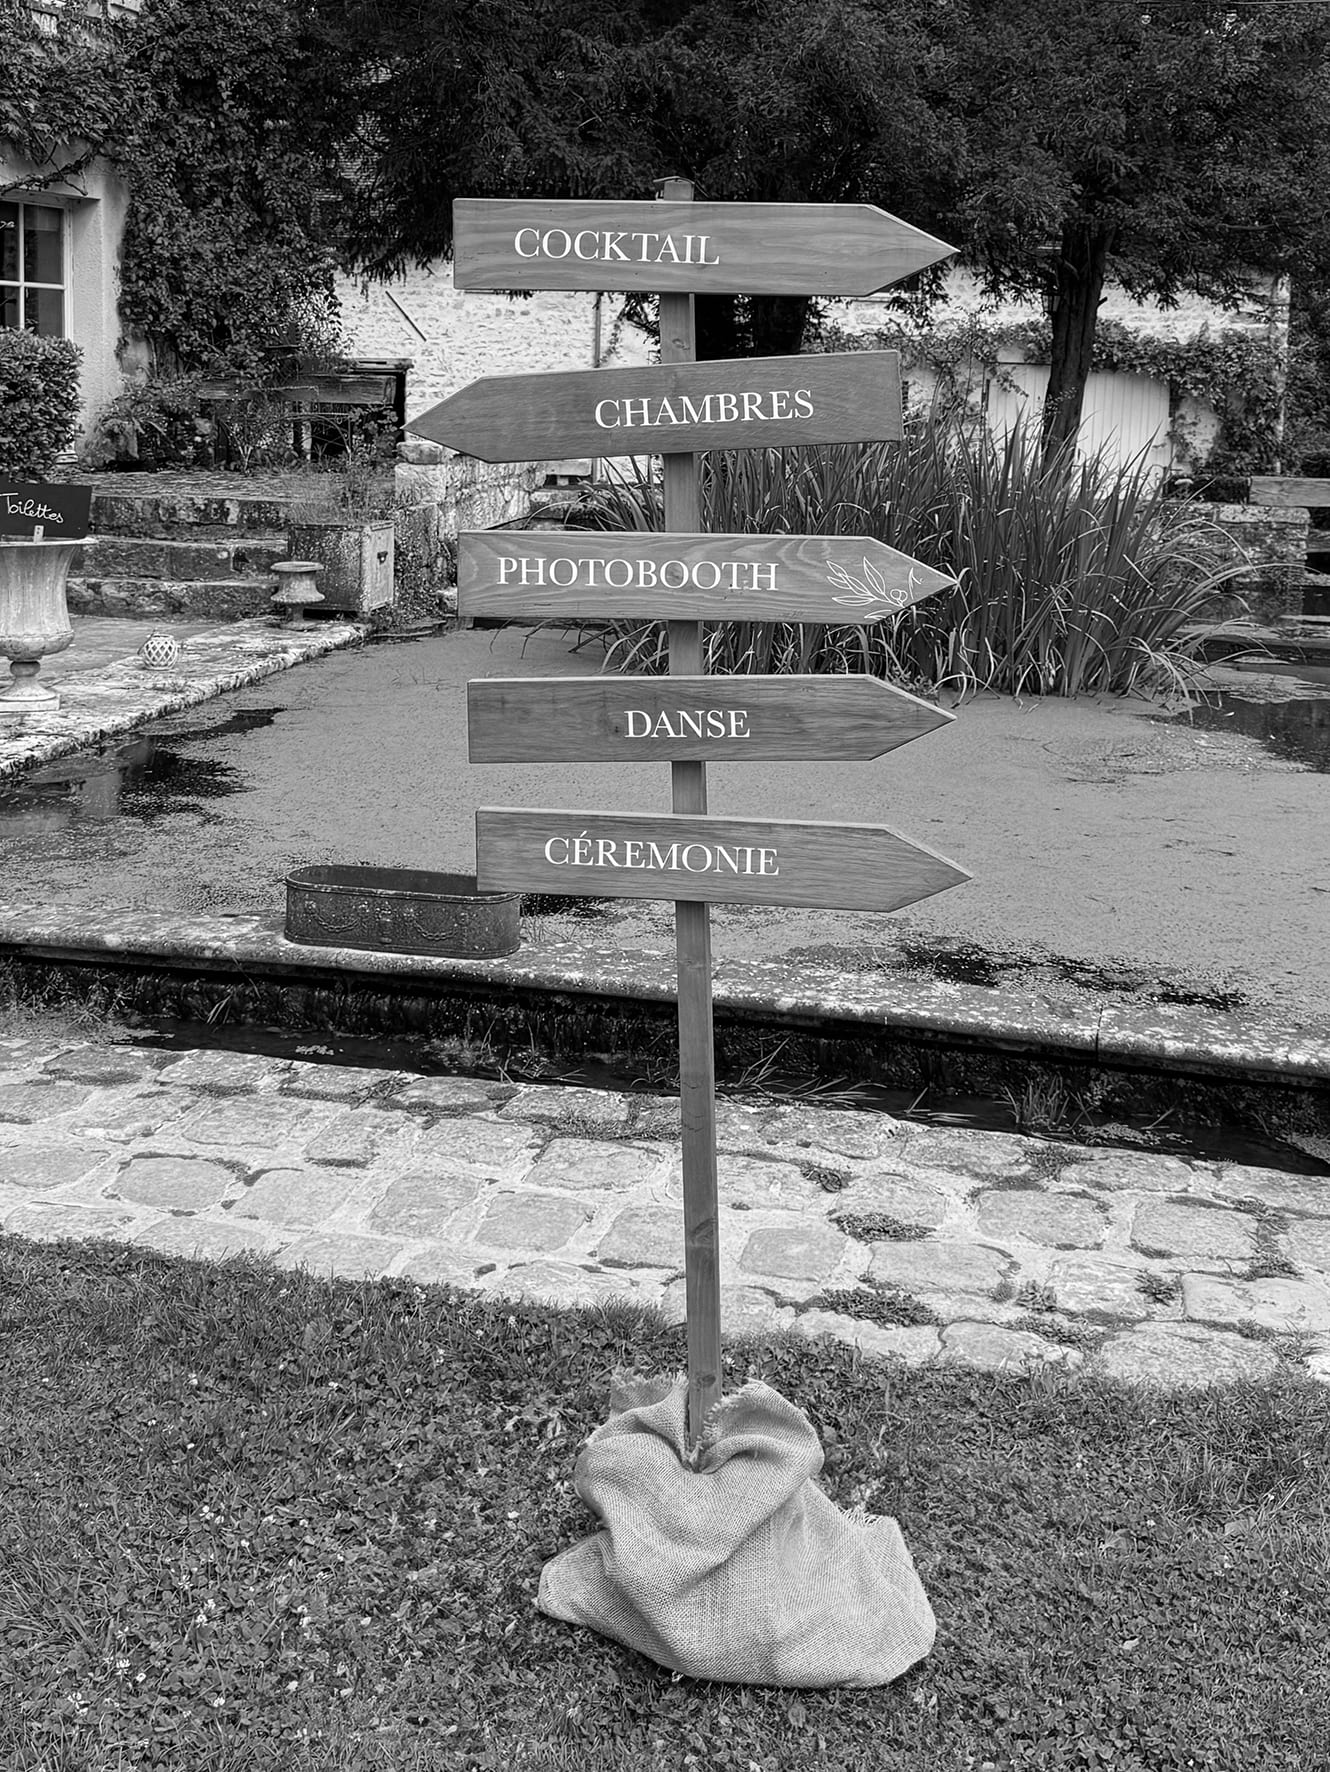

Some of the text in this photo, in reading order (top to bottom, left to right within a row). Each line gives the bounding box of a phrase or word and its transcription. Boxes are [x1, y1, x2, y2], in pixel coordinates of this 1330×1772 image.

[514, 228, 720, 265] COCKTAIL
[595, 390, 814, 429] CHAMBRES
[0, 492, 64, 523] Toilettes
[497, 557, 780, 591] PHOTOBOOTH
[624, 710, 750, 738] DANSE
[544, 831, 780, 876] CÉREMONIE
